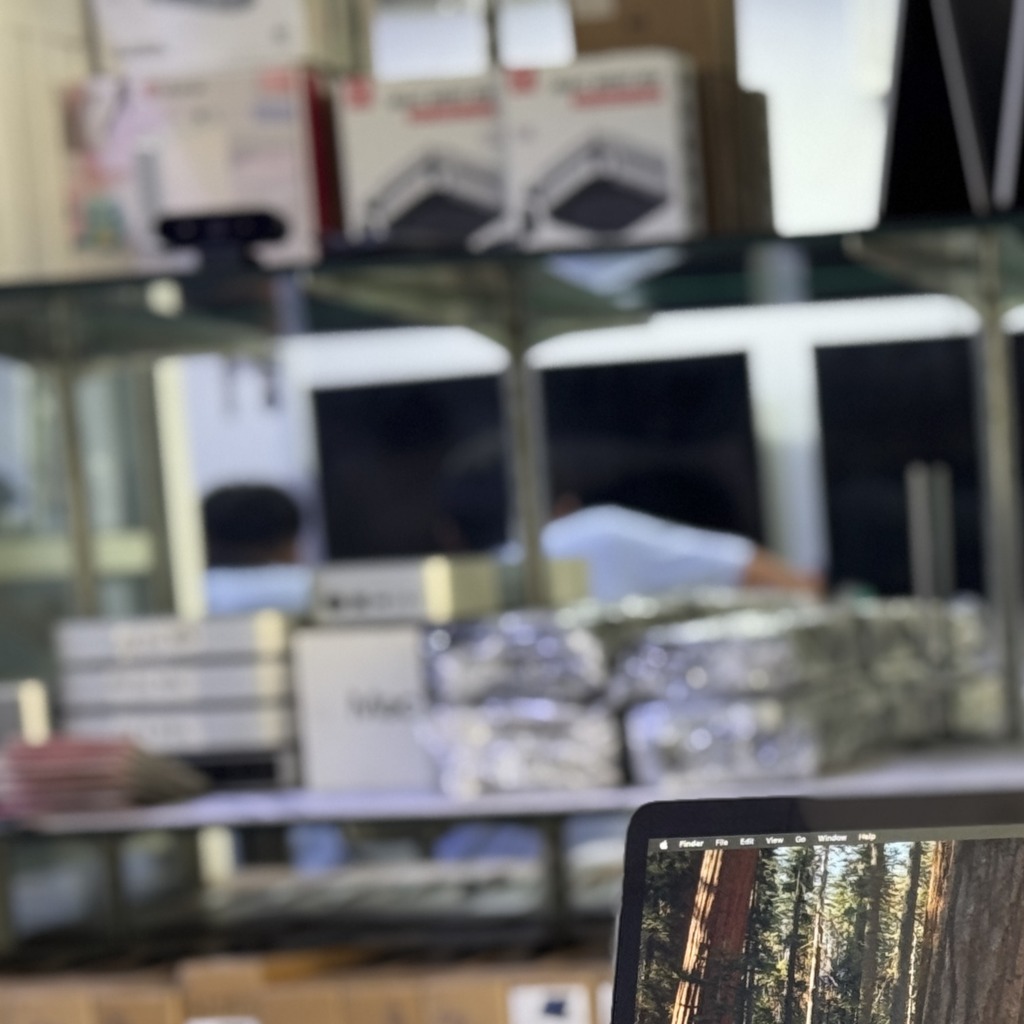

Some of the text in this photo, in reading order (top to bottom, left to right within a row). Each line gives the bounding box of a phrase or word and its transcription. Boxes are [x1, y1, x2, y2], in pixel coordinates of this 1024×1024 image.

[679, 832, 876, 848] Finder File Edit View Go Window Help
